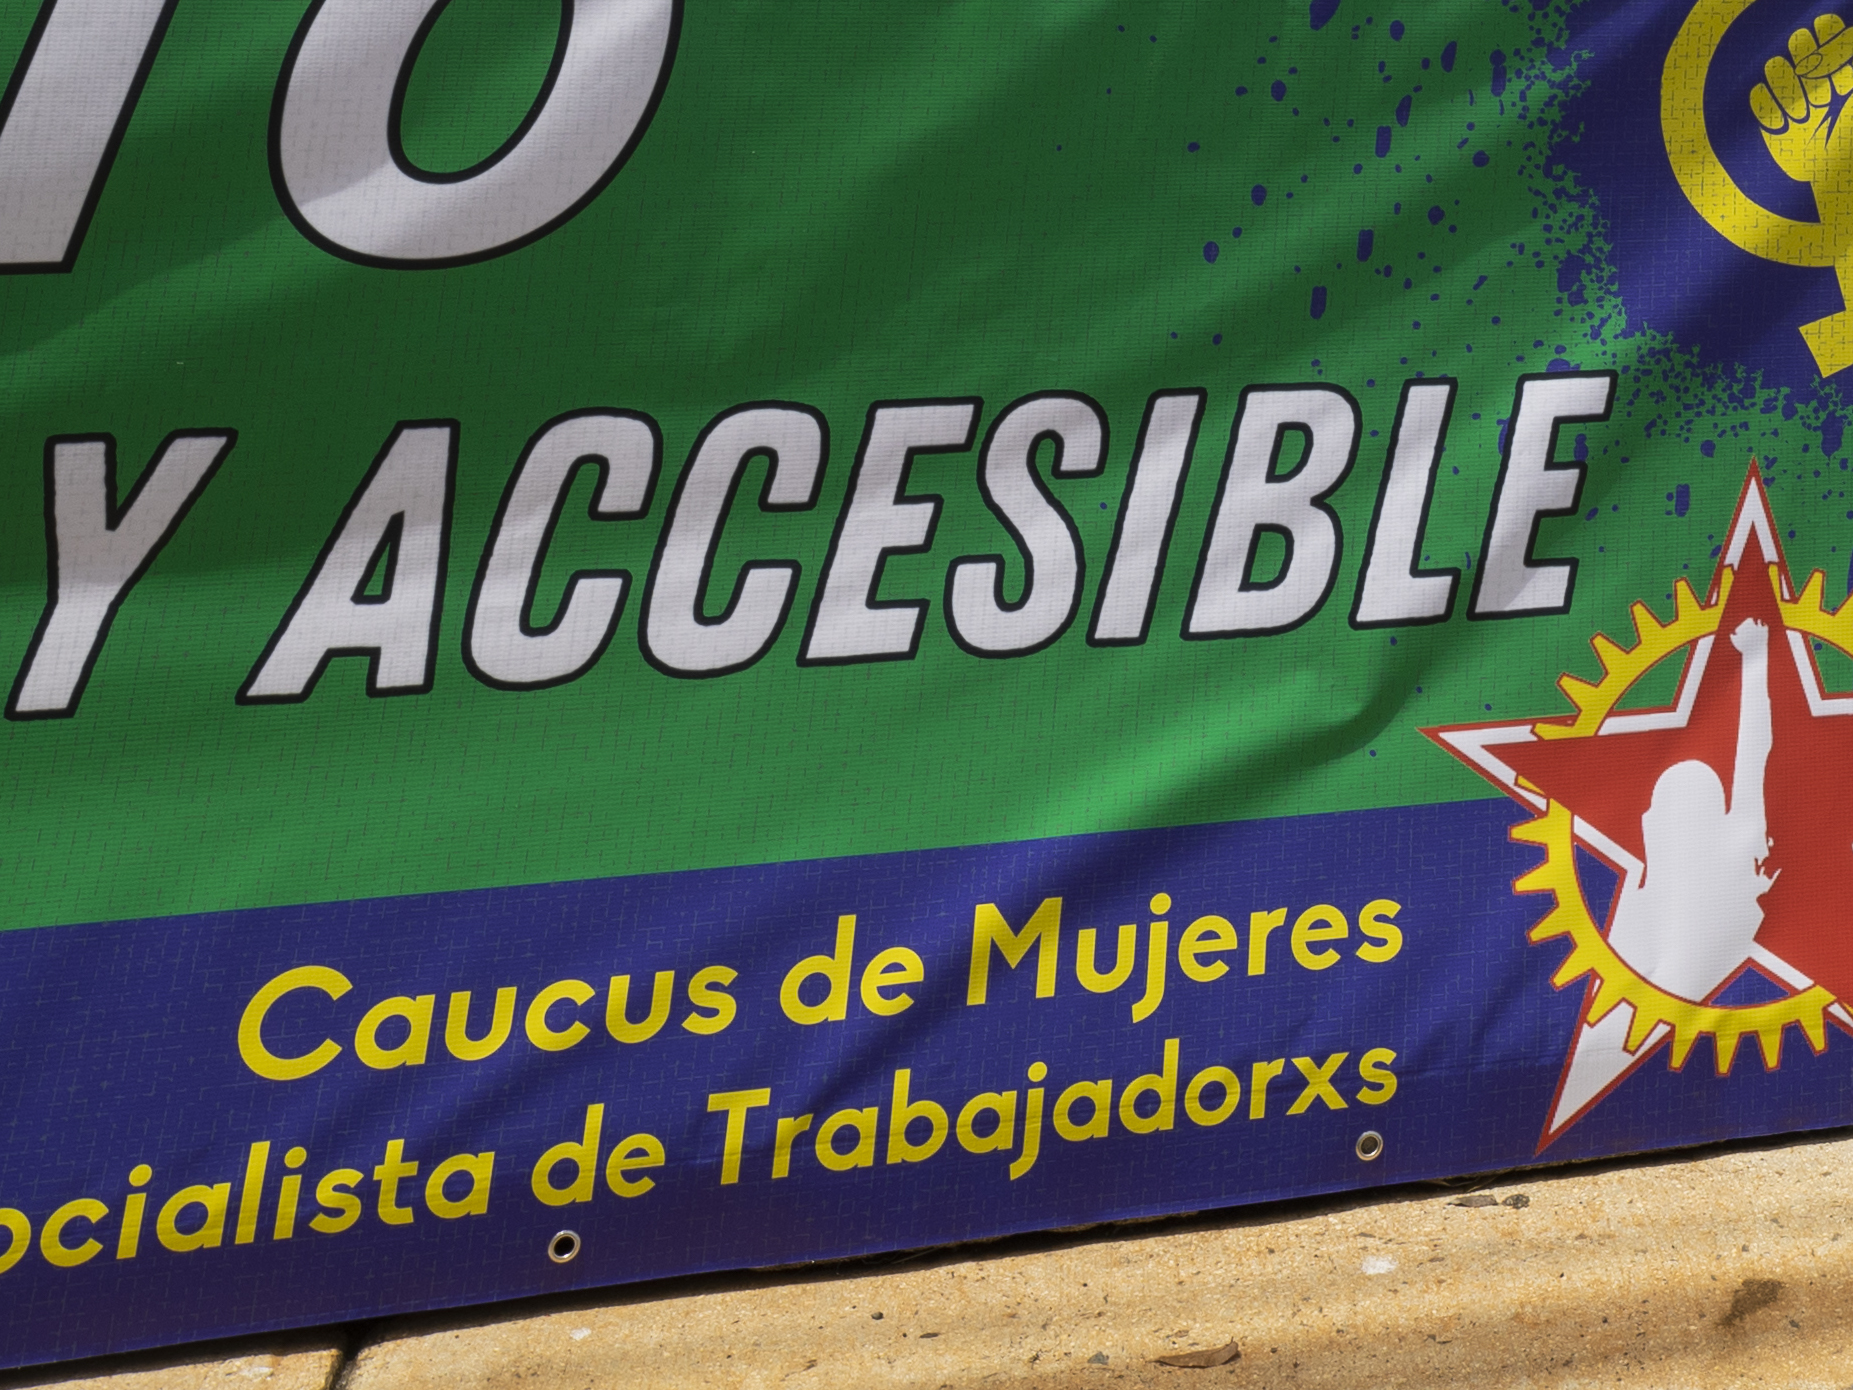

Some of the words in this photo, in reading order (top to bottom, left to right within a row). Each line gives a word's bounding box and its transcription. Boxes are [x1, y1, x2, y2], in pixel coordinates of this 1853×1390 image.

[5, 427, 239, 720] Y
[234, 370, 1619, 706] ACCESIBLE
[236, 958, 739, 1082] Caucus
[779, 913, 926, 1026] de
[965, 891, 1404, 1025] Mujeres
[528, 1101, 666, 1208] de
[706, 1036, 1401, 1187] Trabajadorxs
